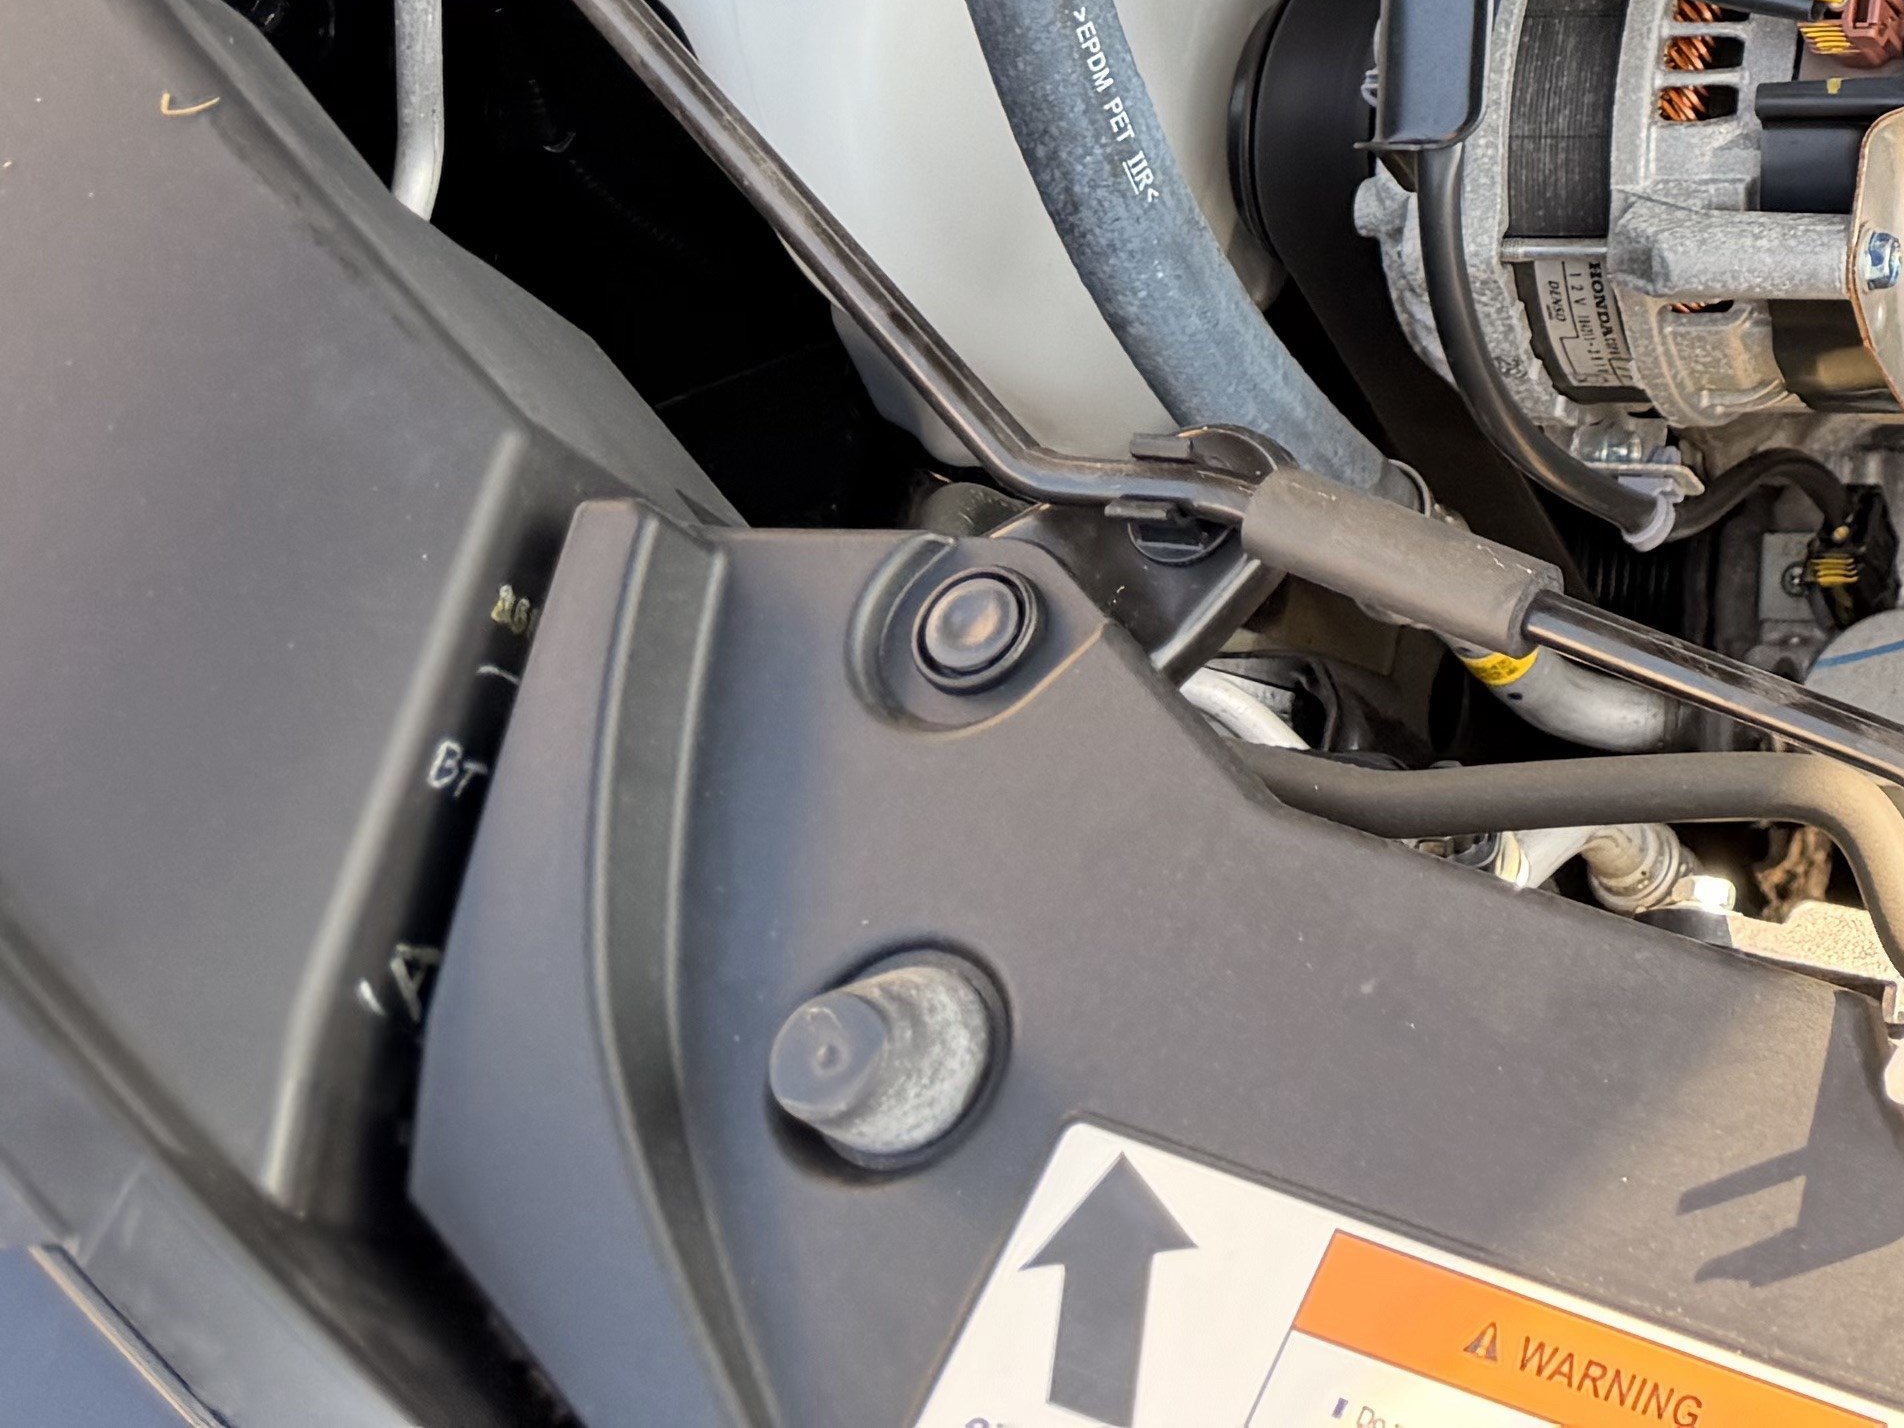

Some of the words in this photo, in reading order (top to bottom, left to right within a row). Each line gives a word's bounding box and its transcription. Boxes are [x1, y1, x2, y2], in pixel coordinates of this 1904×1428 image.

[1072, 9, 1113, 91] >EPDM
[1103, 100, 1136, 143] PET
[1548, 281, 1567, 322] DENSO
[1588, 262, 1614, 338] HONDA
[1517, 1332, 1704, 1428] WARNING
